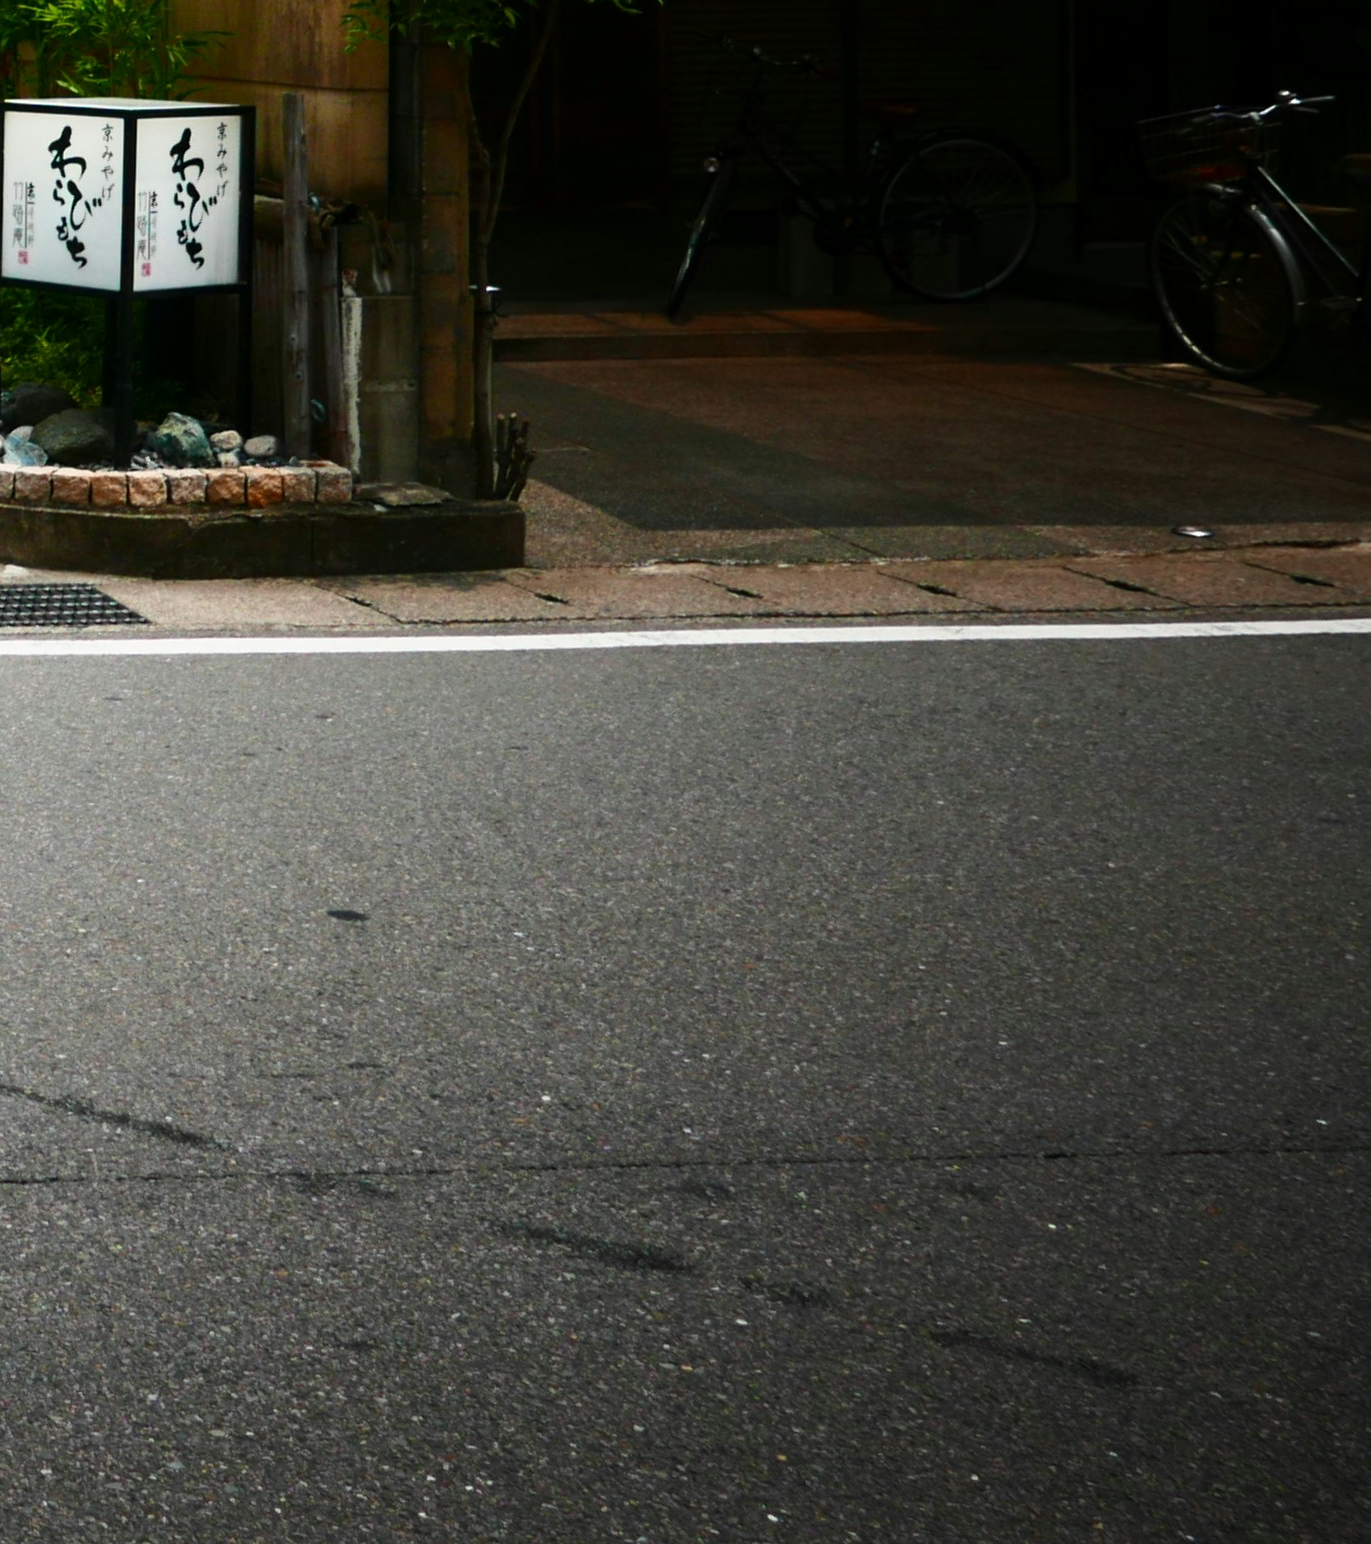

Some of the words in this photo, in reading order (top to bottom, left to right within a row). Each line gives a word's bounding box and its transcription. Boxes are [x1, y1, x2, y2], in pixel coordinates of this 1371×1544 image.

[47, 124, 103, 271] わらびもち
[169, 127, 218, 271] わらびもち
